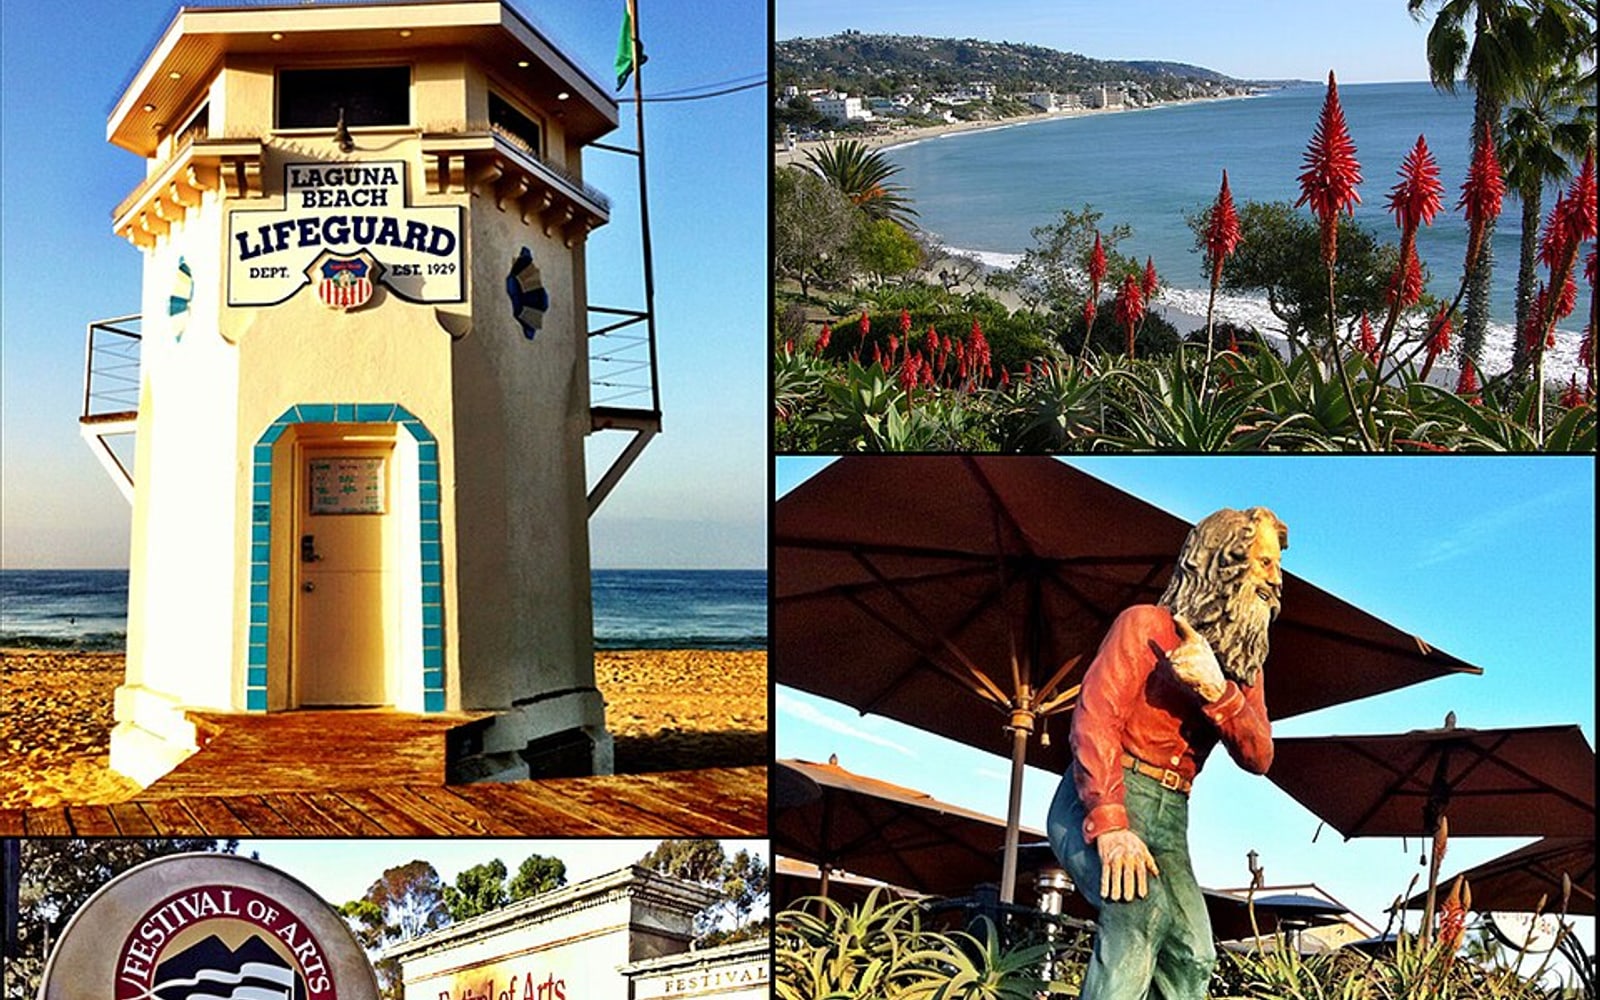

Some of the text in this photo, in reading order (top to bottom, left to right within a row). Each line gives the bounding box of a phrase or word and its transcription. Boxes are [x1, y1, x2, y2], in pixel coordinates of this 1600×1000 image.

[291, 167, 398, 188] LAGUNA
[302, 189, 388, 209] BEACH
[235, 215, 456, 262] LIFEGUARD
[250, 266, 290, 279] DEPT.
[392, 263, 456, 276] EST. 1929
[123, 890, 331, 994] FESTIVAL OF ARTS
[523, 971, 566, 1000] Arts
[665, 967, 768, 993] FESTIVAL
